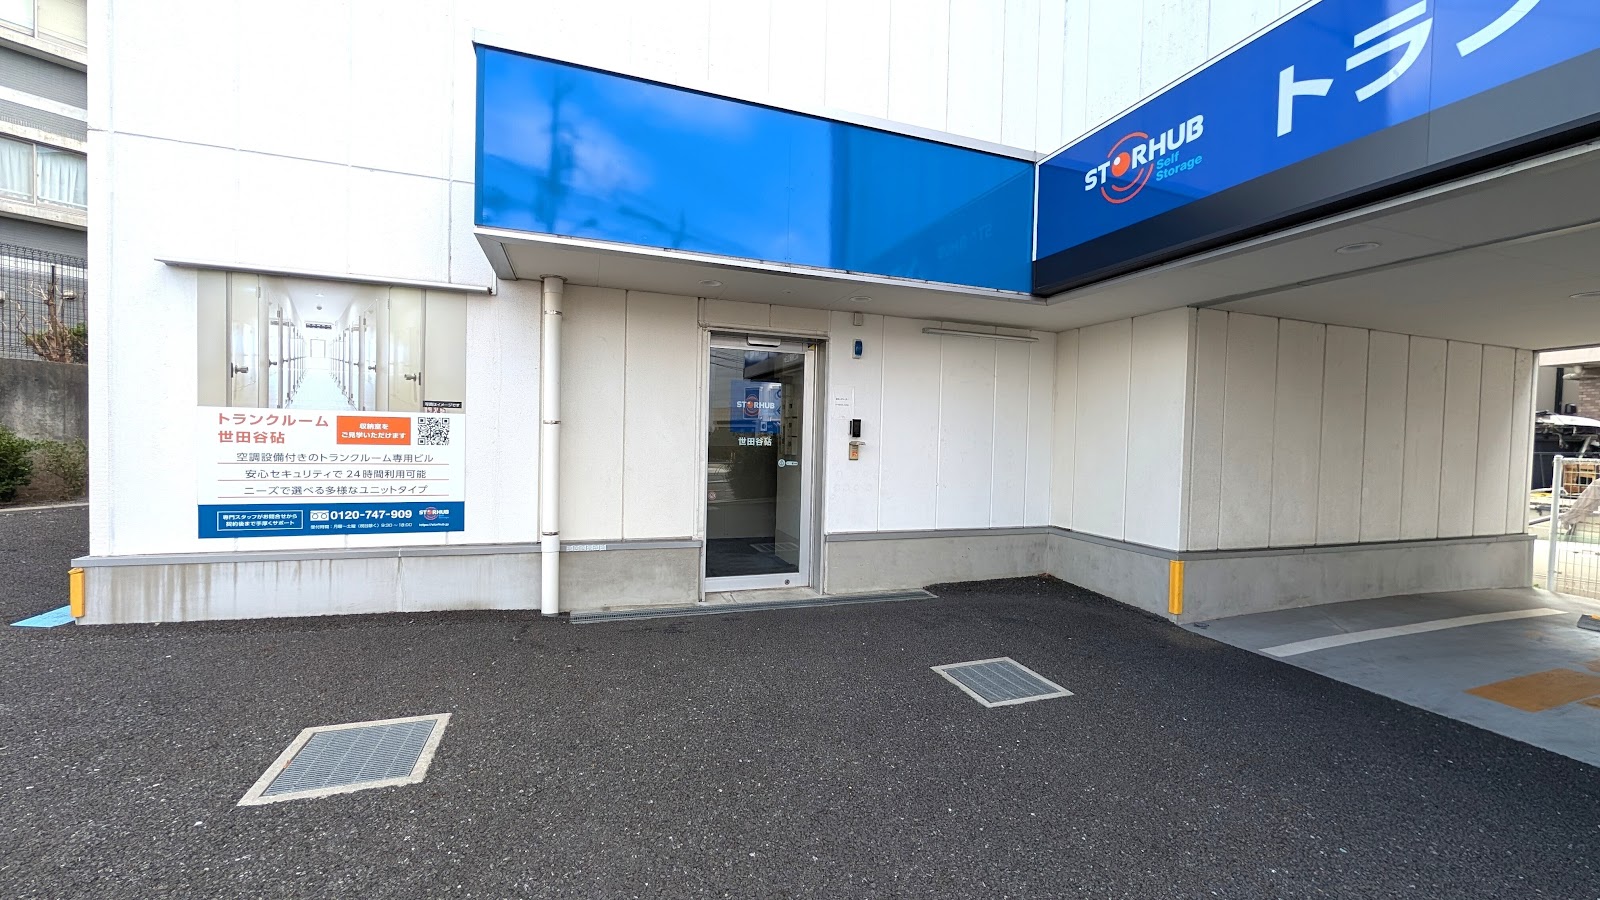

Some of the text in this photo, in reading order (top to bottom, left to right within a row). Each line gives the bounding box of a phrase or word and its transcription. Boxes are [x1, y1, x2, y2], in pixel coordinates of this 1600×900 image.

[1084, 114, 1204, 192] STORHUB
[1156, 150, 1180, 171] Self
[1155, 155, 1203, 182] Storage
[736, 400, 775, 409] STORHUB
[218, 412, 329, 427] トランクルーム
[359, 422, 389, 431] 収納室を
[217, 430, 286, 444] 世田谷砧
[341, 431, 407, 439] ご見学いただけます
[738, 436, 773, 447] 世田谷砧
[236, 452, 434, 463] 空調設備付きのトランクルーム専用ビル
[243, 485, 429, 496] ニーズで選べる多様なユニットタイプ
[329, 509, 413, 520] 0120-747-909
